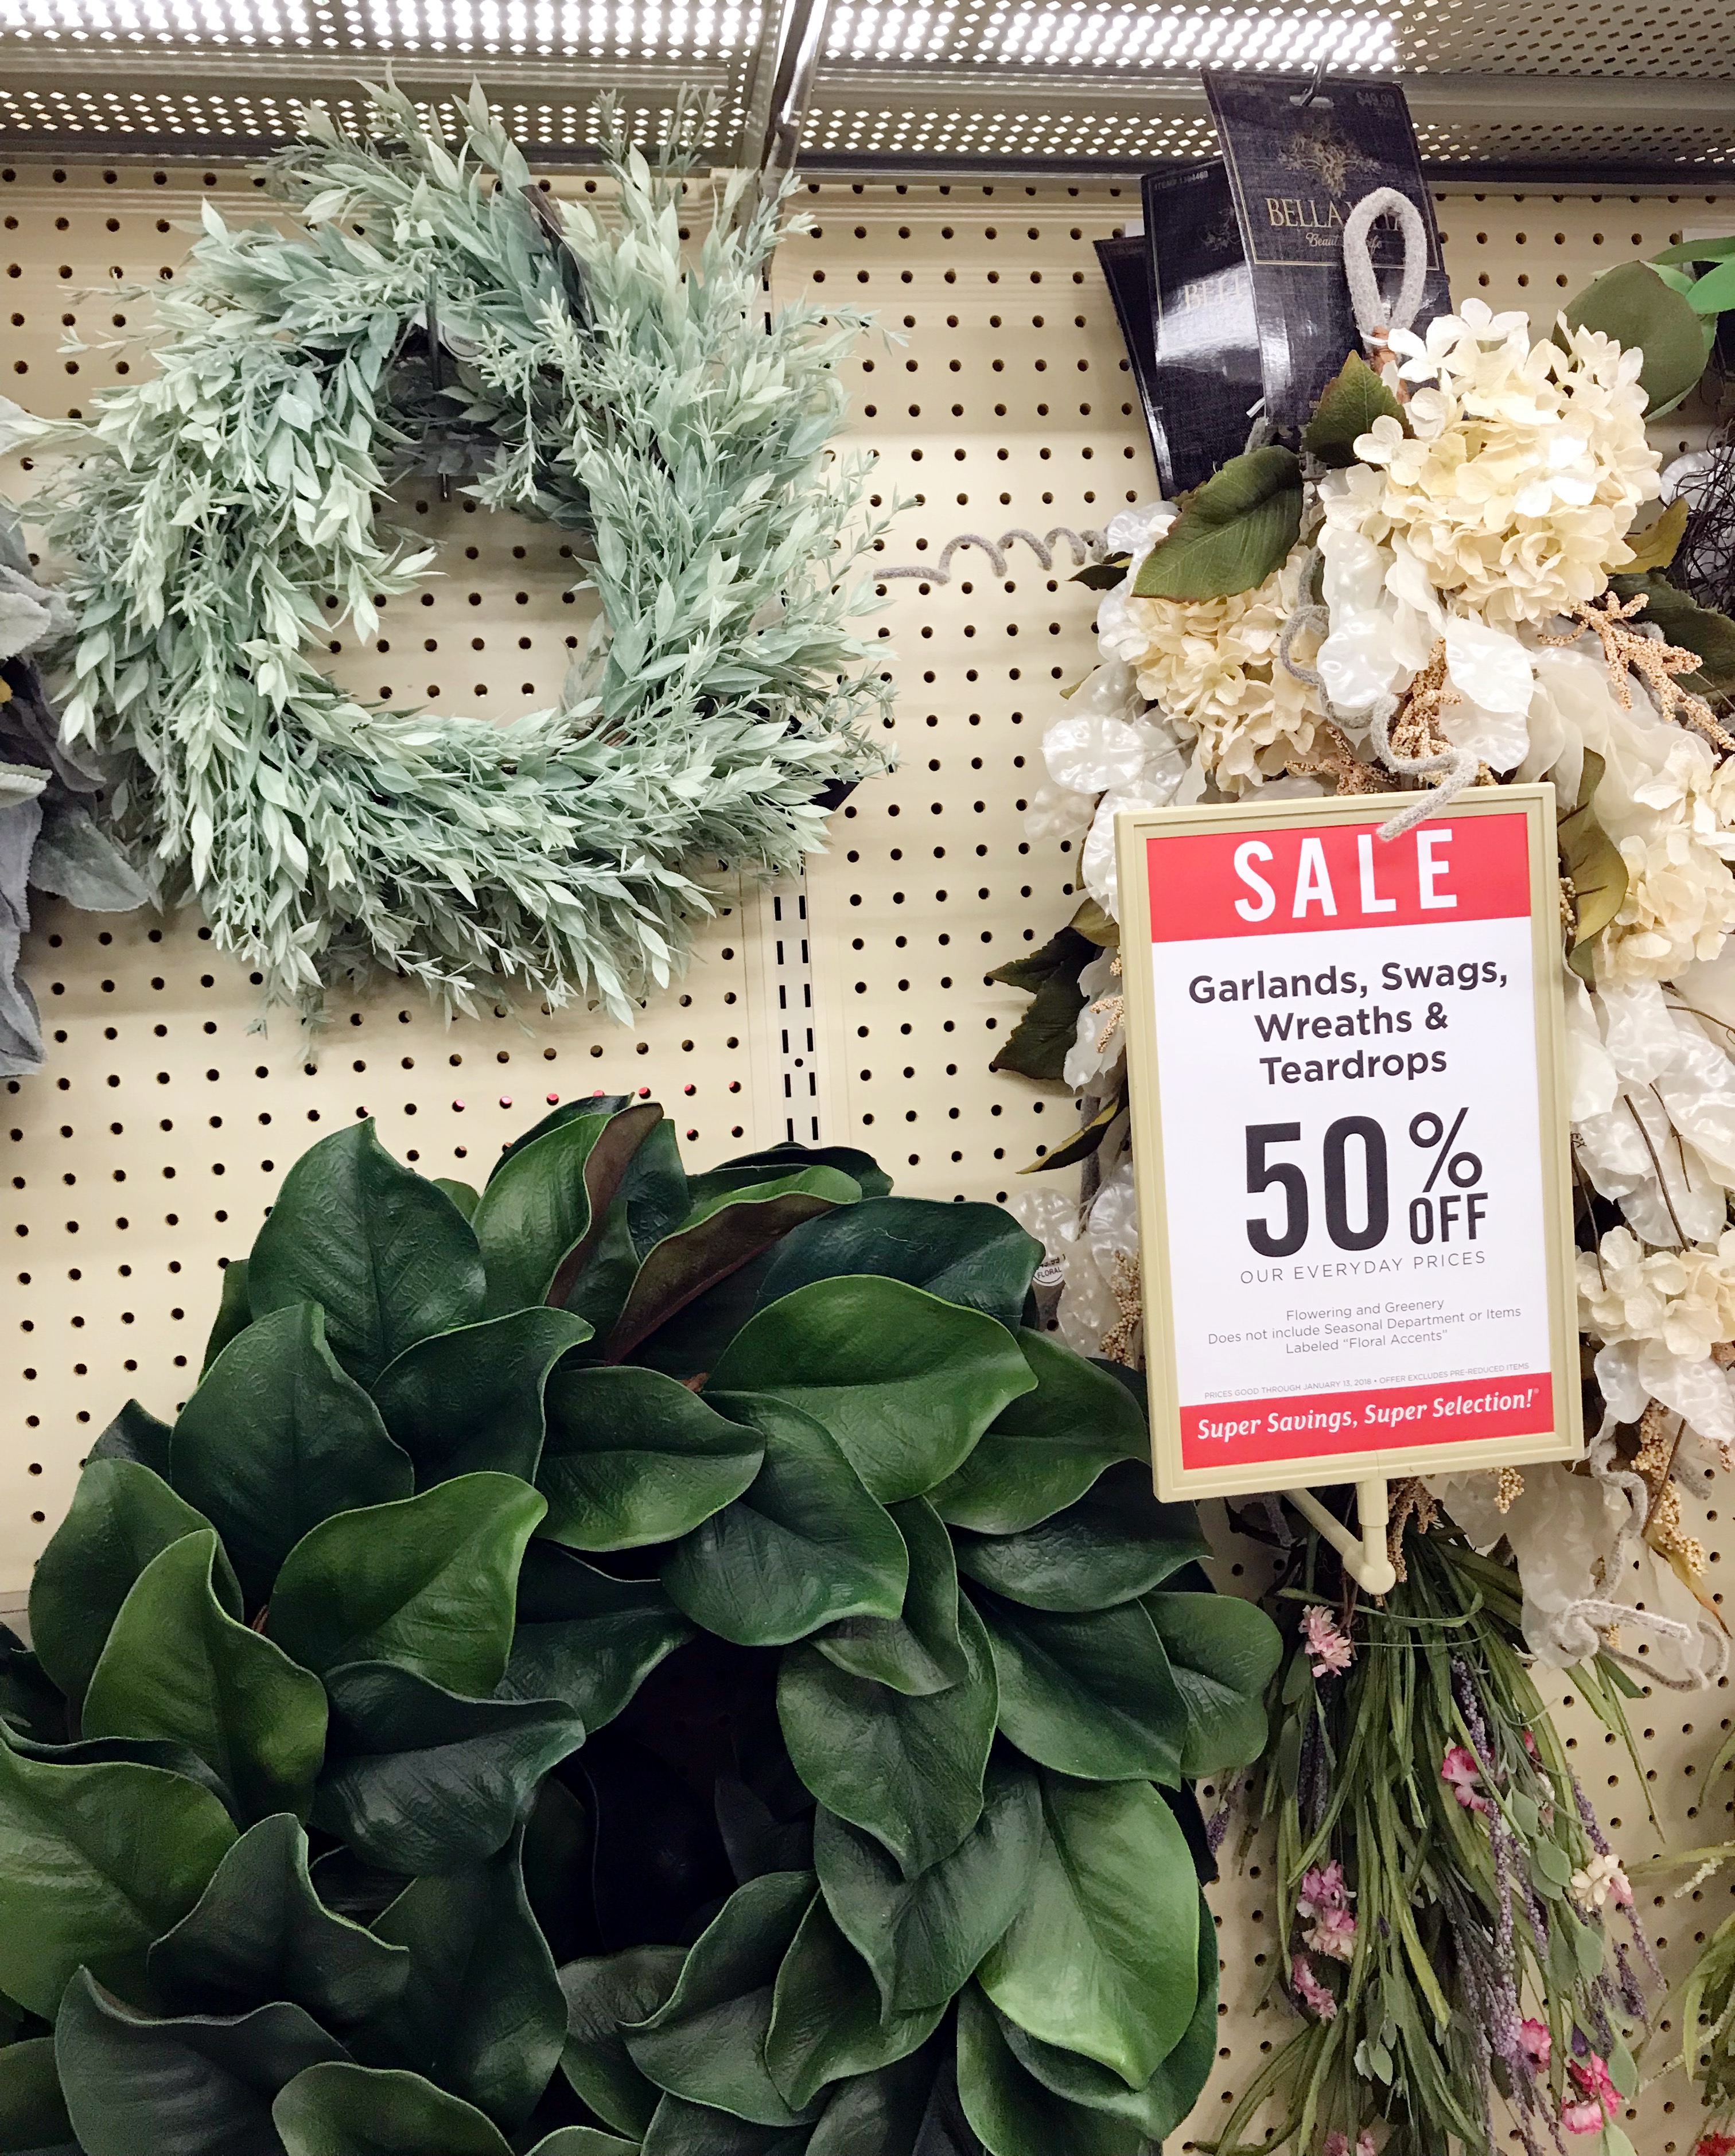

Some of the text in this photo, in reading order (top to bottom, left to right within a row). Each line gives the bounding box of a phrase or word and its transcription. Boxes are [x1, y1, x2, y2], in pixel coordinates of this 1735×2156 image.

[1265, 198, 1344, 228] BELLA
[1305, 232, 1343, 247] Beaut
[1234, 828, 1457, 922] SALE
[1189, 961, 1507, 1004] Garlands, Swags,
[1255, 1002, 1448, 1042] Wreaths &
[1259, 1050, 1447, 1084] Teardrops
[1409, 1192, 1488, 1245] OFF
[1037, 1267, 1062, 1279] FLORAL
[1240, 1251, 1485, 1284] OUR EVERYDAY PRICES
[1208, 1307, 1522, 1344] Does not include Seasonal Department or Items
[1286, 1299, 1445, 1322] Flowering and Greenery
[1286, 1340, 1339, 1354] Labeled
[1205, 1390, 1232, 1399] PRICES
[1235, 1388, 1259, 1396] GOOD
[1262, 1384, 1301, 1394] THROUGH
[1303, 1380, 1341, 1390] JANUARY
[1354, 1378, 1372, 1386] 2018
[1379, 1375, 1406, 1384] OFFER
[1409, 1371, 1448, 1381] EXCLUDES
[1450, 1364, 1504, 1376] PRE-REDUCED
[1507, 1363, 1529, 1371] ITEMS
[1197, 1388, 1533, 1442] Super Savings, Super Selection!
